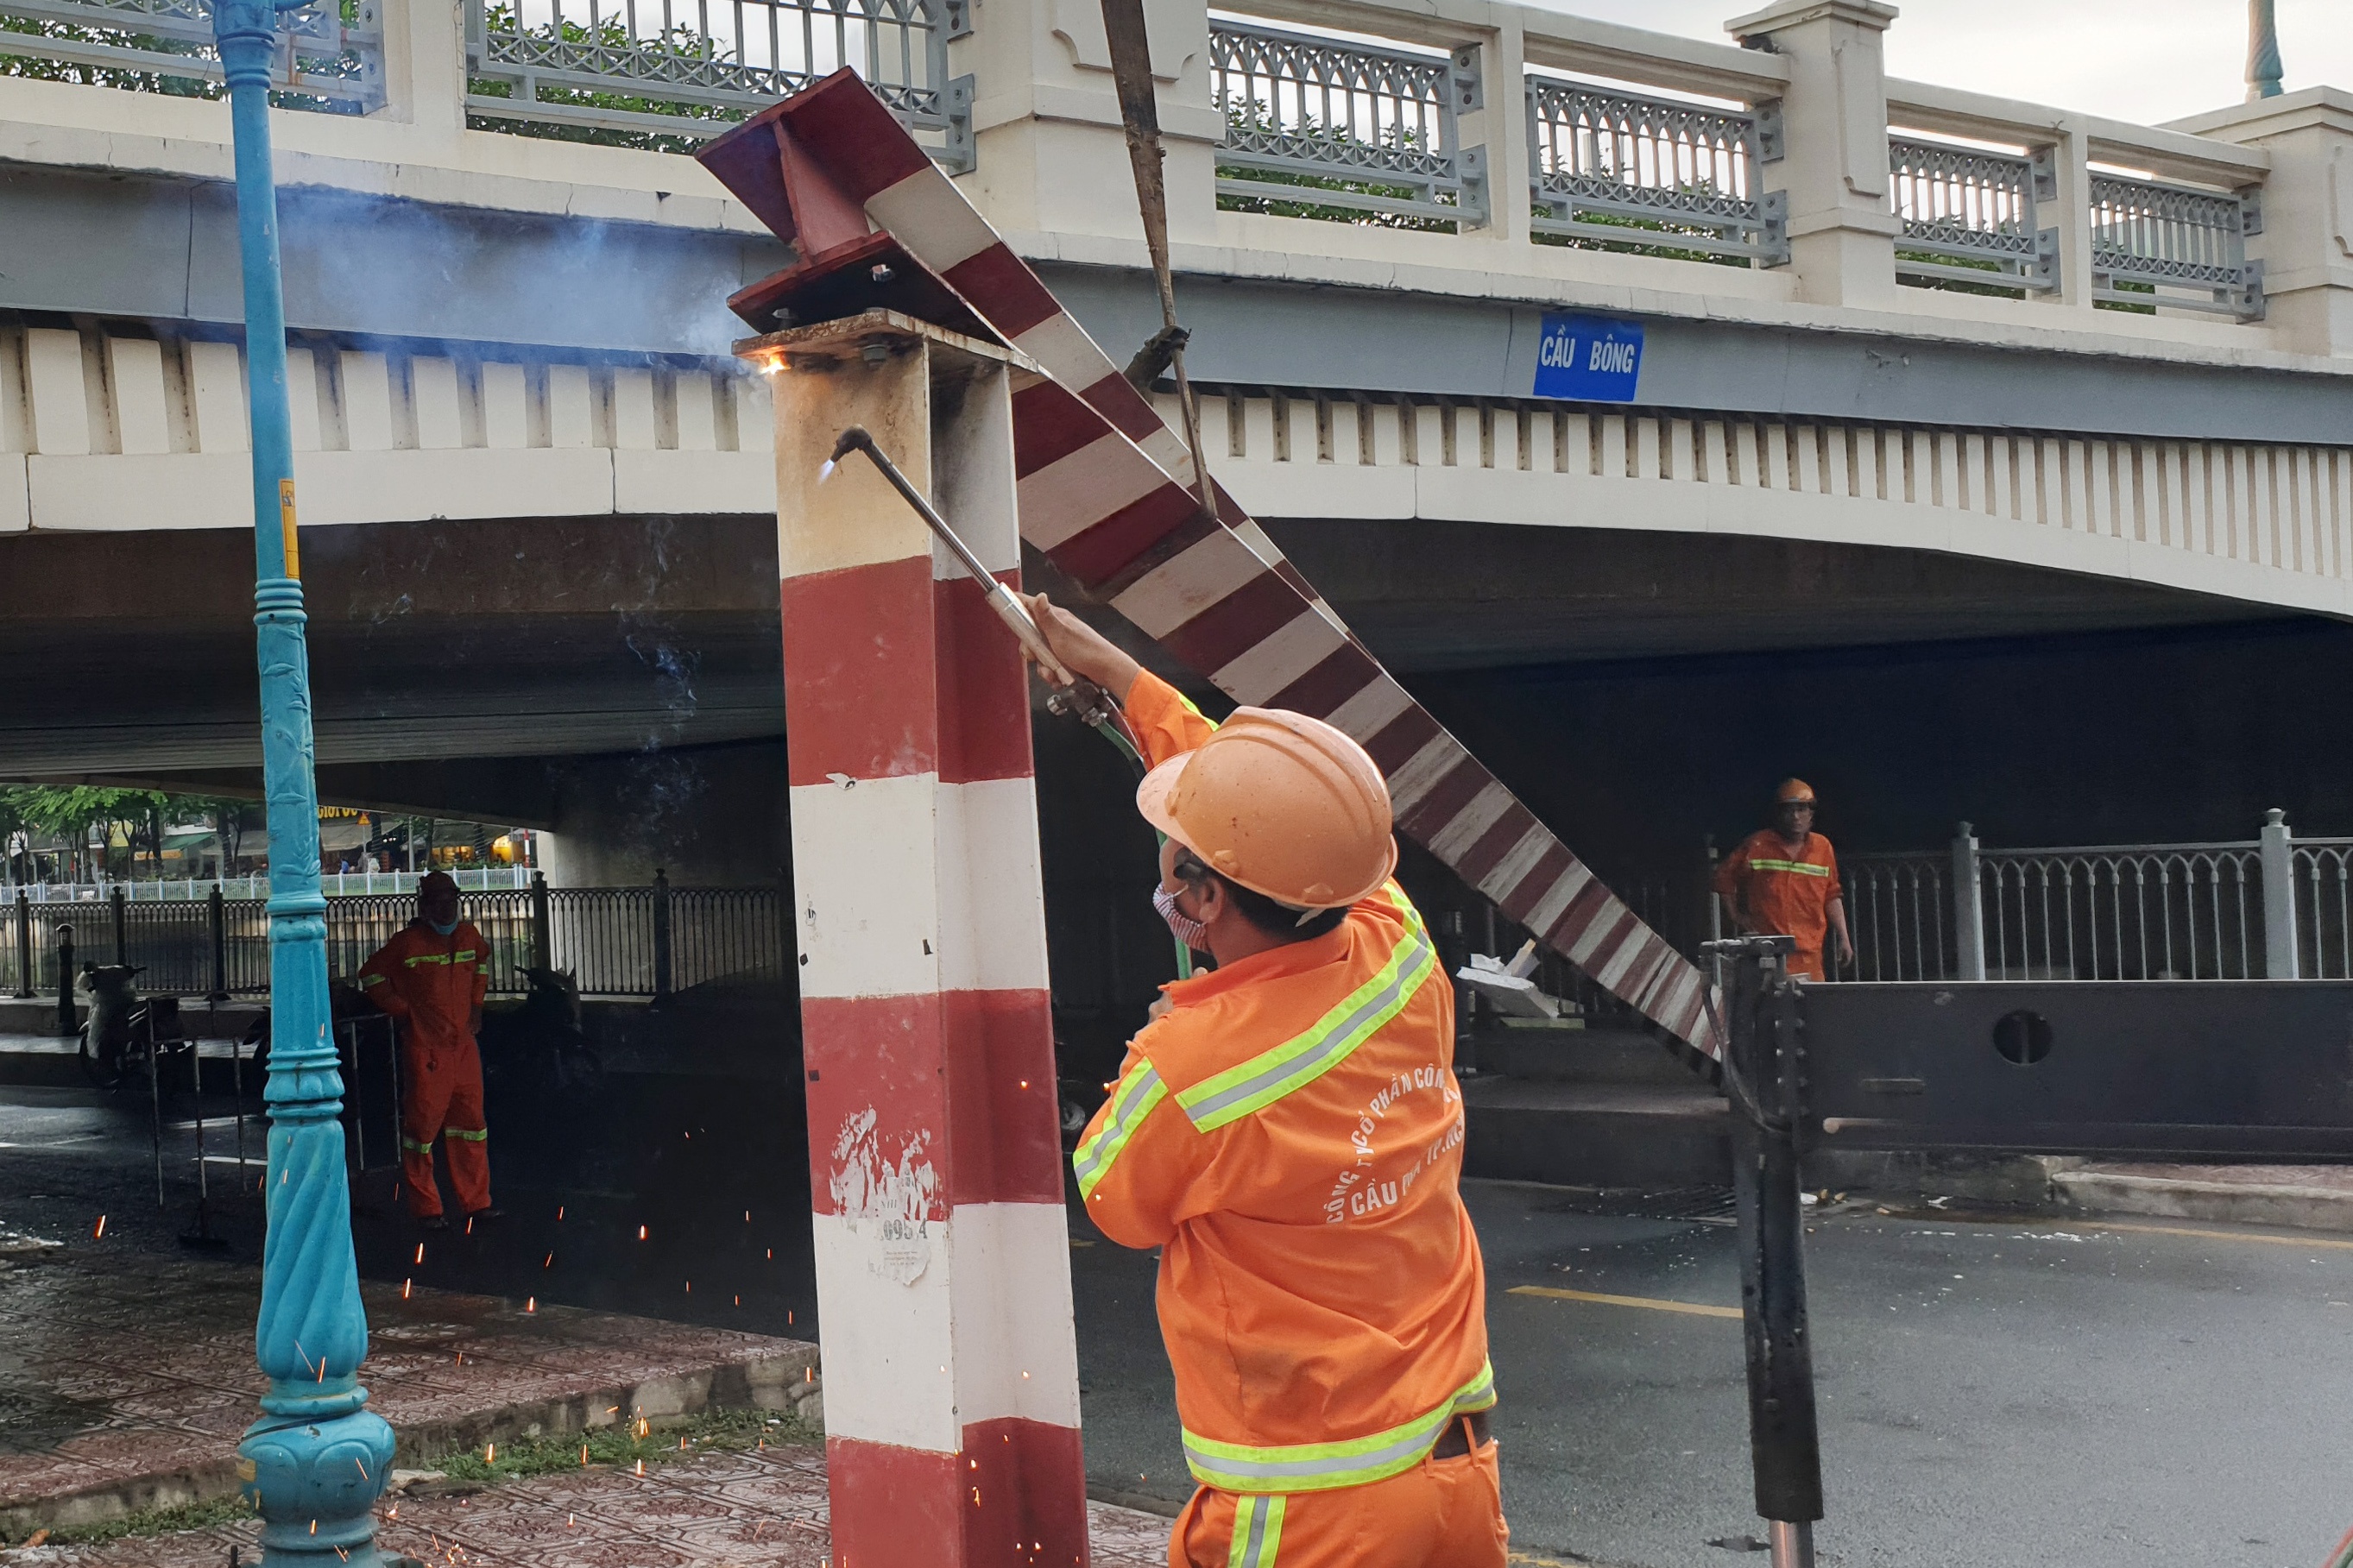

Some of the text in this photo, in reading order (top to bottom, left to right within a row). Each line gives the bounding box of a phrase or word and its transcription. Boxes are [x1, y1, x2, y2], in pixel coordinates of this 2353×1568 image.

[1541, 324, 1636, 374] CẦU BÔNG
[1323, 1170, 1360, 1224] CÔNG
[1351, 1109, 1376, 1148] CỔ
[1369, 1072, 1413, 1118] PHẦN
[1350, 1178, 1398, 1216] CẦU
